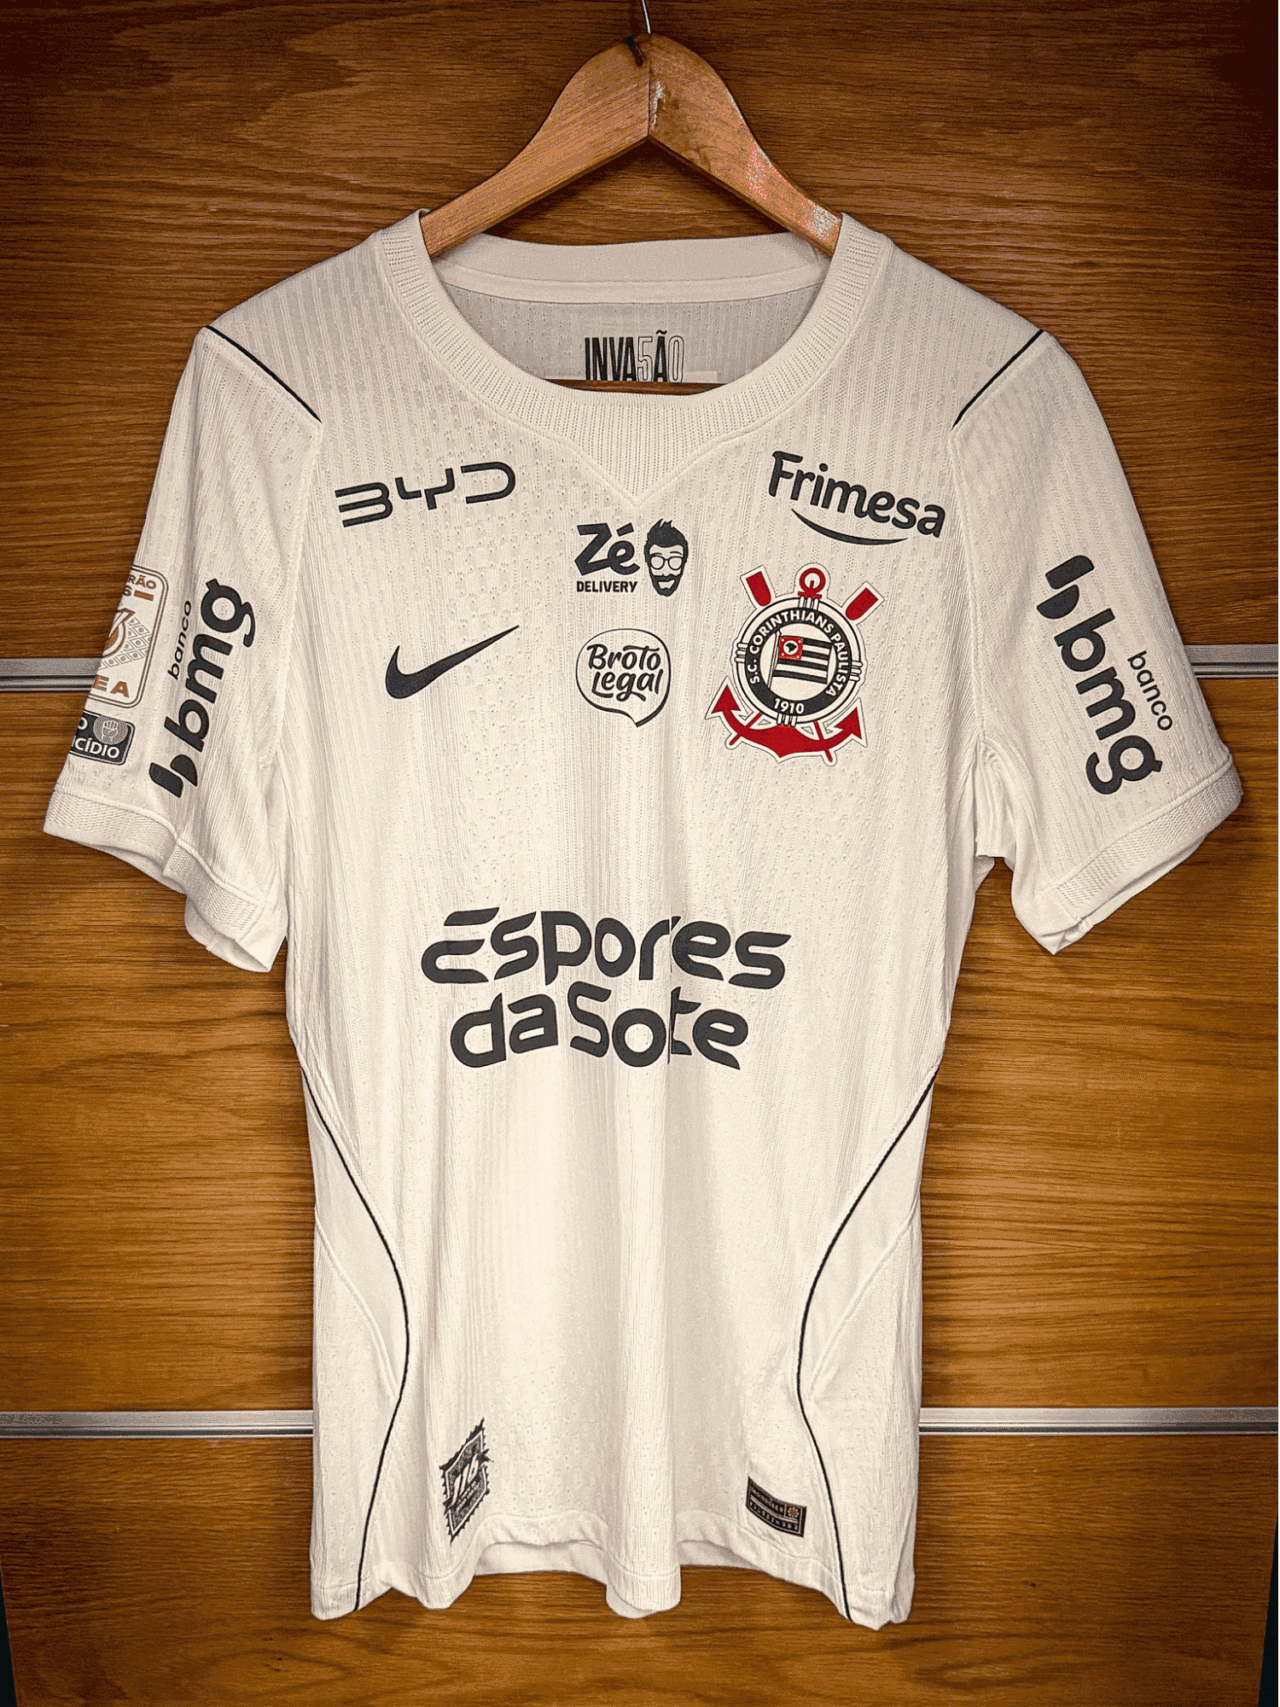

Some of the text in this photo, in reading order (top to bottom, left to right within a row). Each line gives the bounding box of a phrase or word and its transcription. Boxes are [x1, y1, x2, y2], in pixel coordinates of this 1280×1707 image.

[334, 461, 516, 528] BYD
[767, 450, 947, 539] Frimesa
[574, 522, 640, 576] Zé
[576, 581, 638, 593] DELIVERY
[164, 578, 256, 753] bmg
[167, 600, 192, 680] banco
[586, 644, 661, 671] Broto
[749, 609, 835, 655] CORINTHIANS
[825, 633, 850, 697] PAULISTA
[591, 669, 664, 702] Legal
[773, 698, 805, 715] 1910
[1053, 607, 1163, 795] bmg
[1127, 649, 1173, 731] banco
